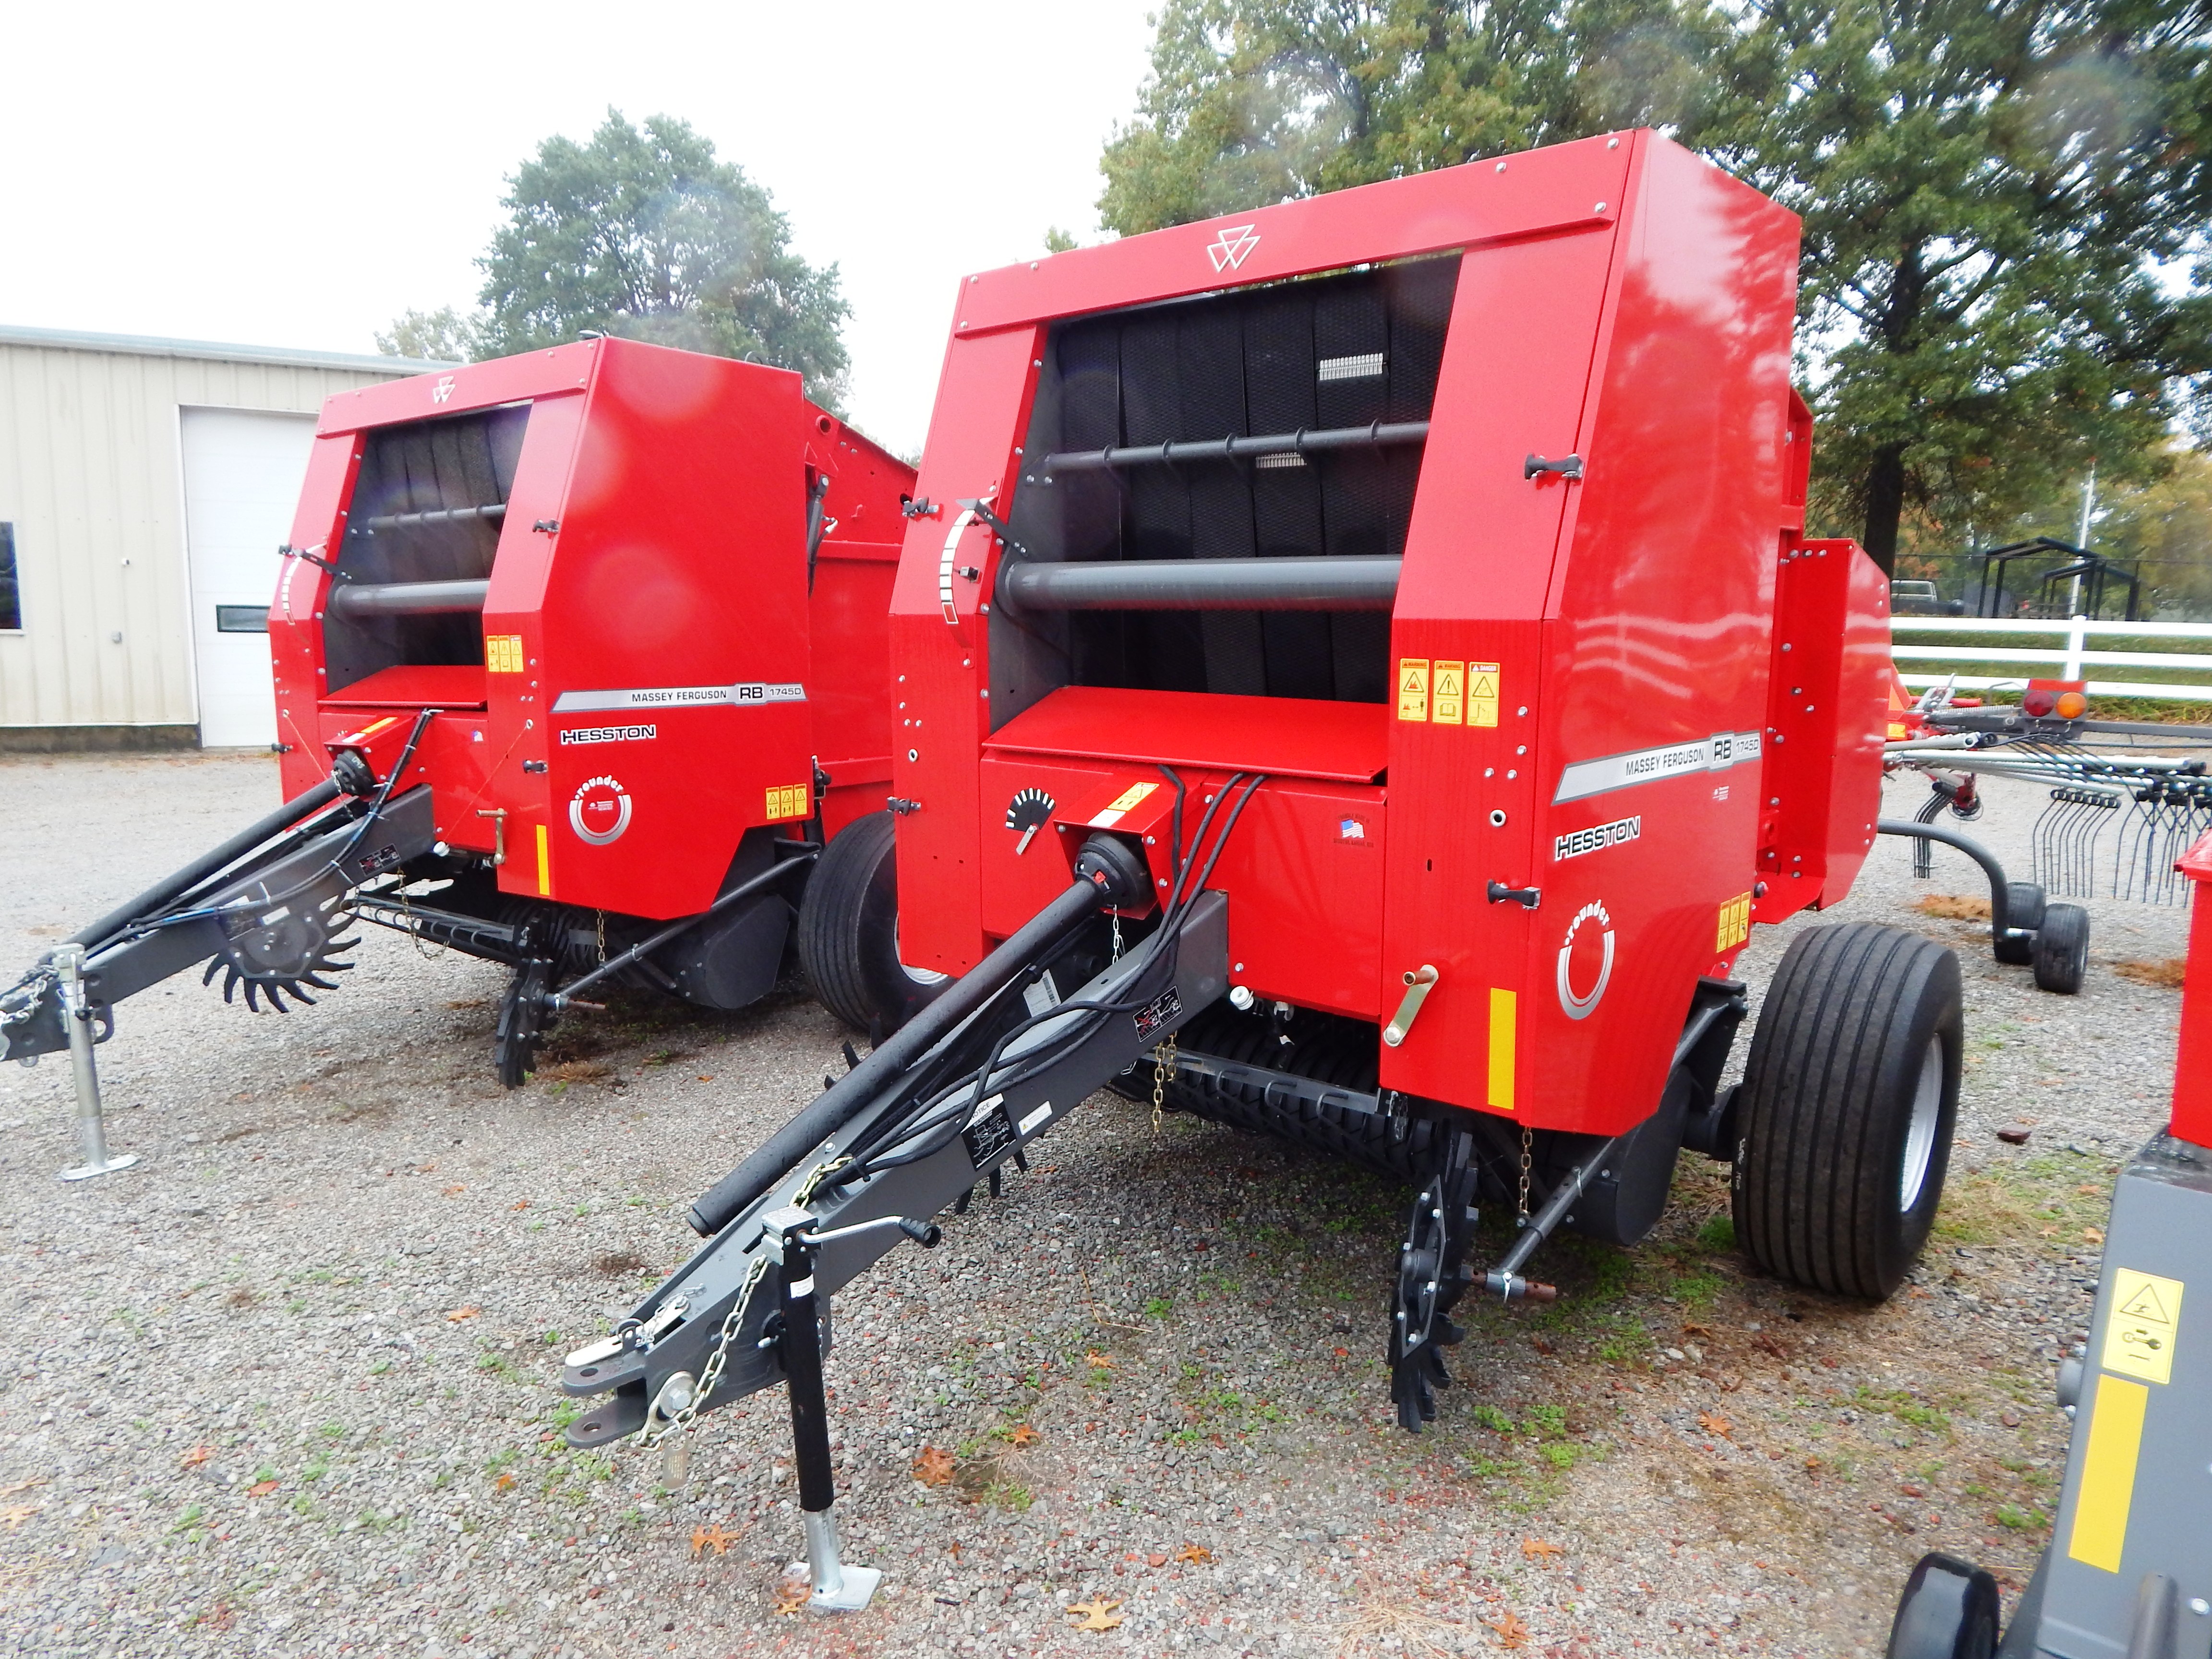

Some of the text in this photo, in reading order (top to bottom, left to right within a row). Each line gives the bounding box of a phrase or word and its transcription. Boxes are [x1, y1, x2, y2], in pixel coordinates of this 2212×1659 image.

[632, 686, 801, 702] MASSEY FERGUSON RB 1745D
[562, 725, 655, 743] HESSTON
[1625, 738, 1759, 776] MASSEY FERGUSON RB 1745D
[1556, 816, 1640, 858] HESSTON
